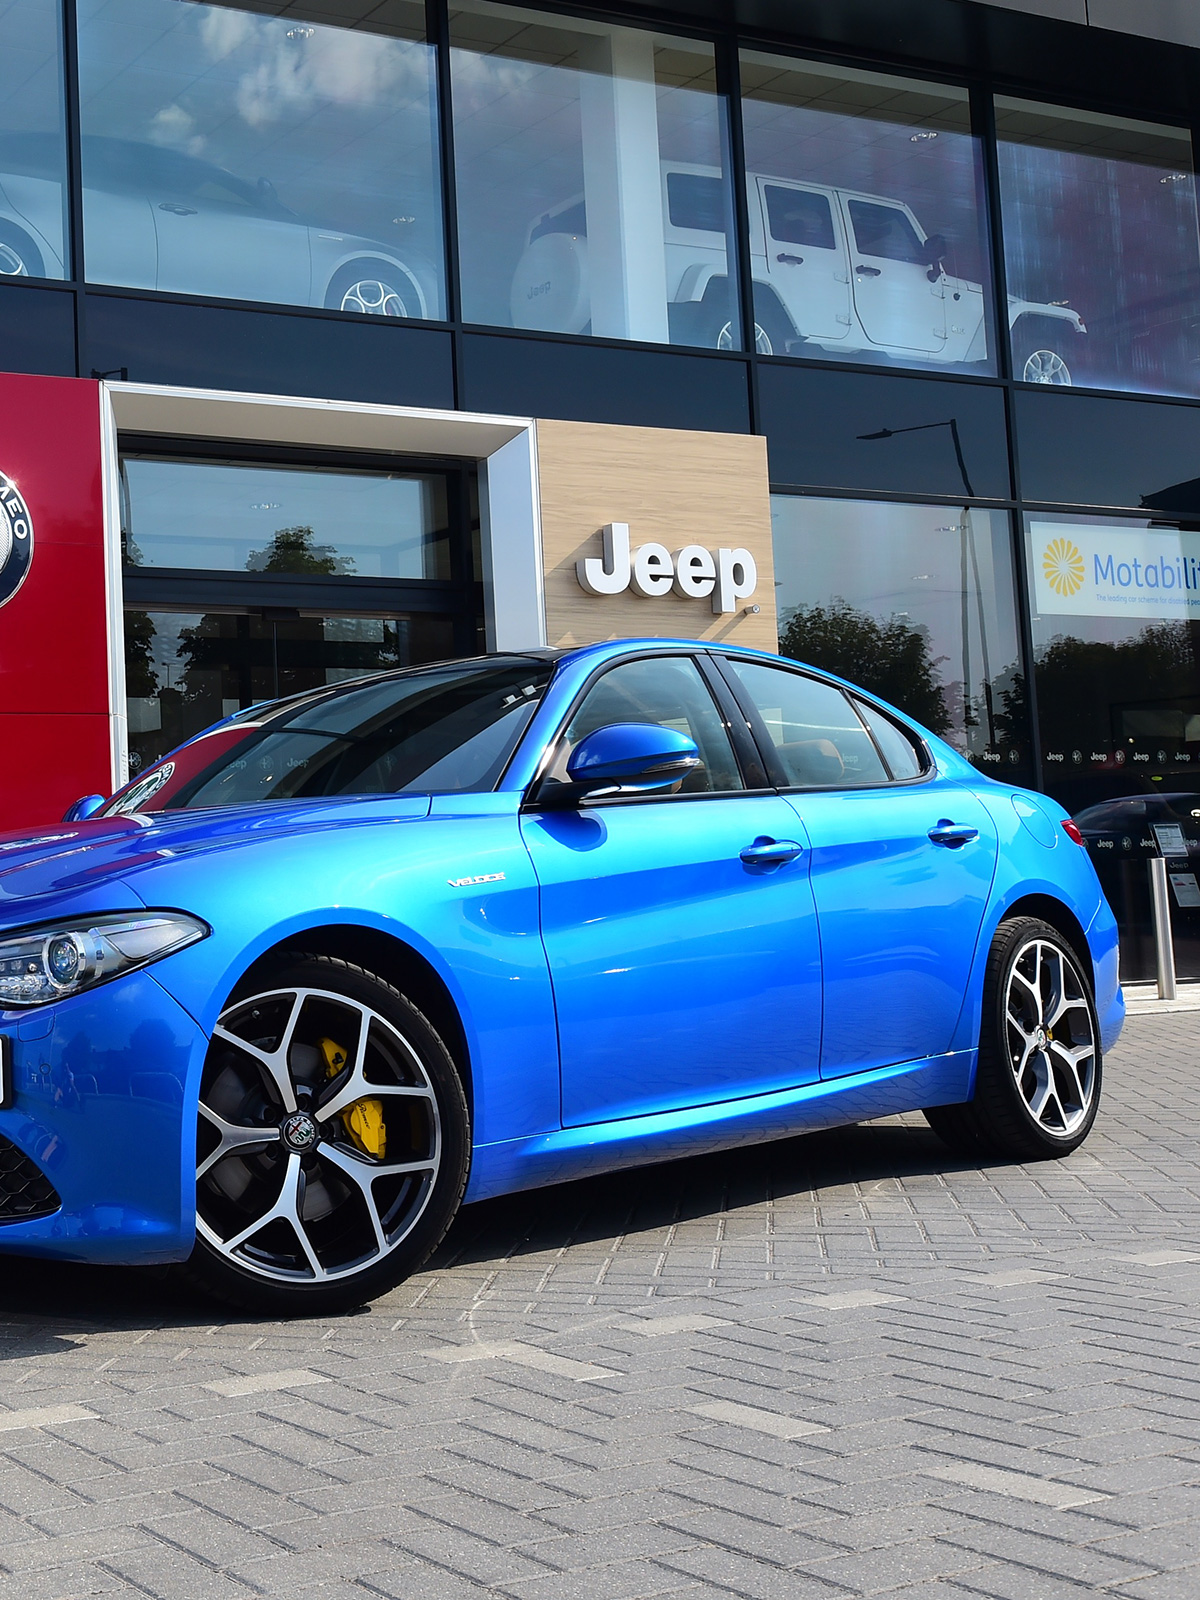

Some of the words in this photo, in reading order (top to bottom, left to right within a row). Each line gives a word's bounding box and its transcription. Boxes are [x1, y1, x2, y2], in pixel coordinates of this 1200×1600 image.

[576, 521, 758, 614] Jeep
[1093, 554, 1200, 590] Motabili
[982, 751, 1001, 762] Jeep
[1046, 751, 1064, 762] Jeep
[1090, 751, 1108, 762] Jeep
[1133, 751, 1150, 762] Jeep
[1174, 751, 1191, 762] Jeep
[1097, 839, 1113, 848] Jeep
[1140, 838, 1156, 848] Jeep
